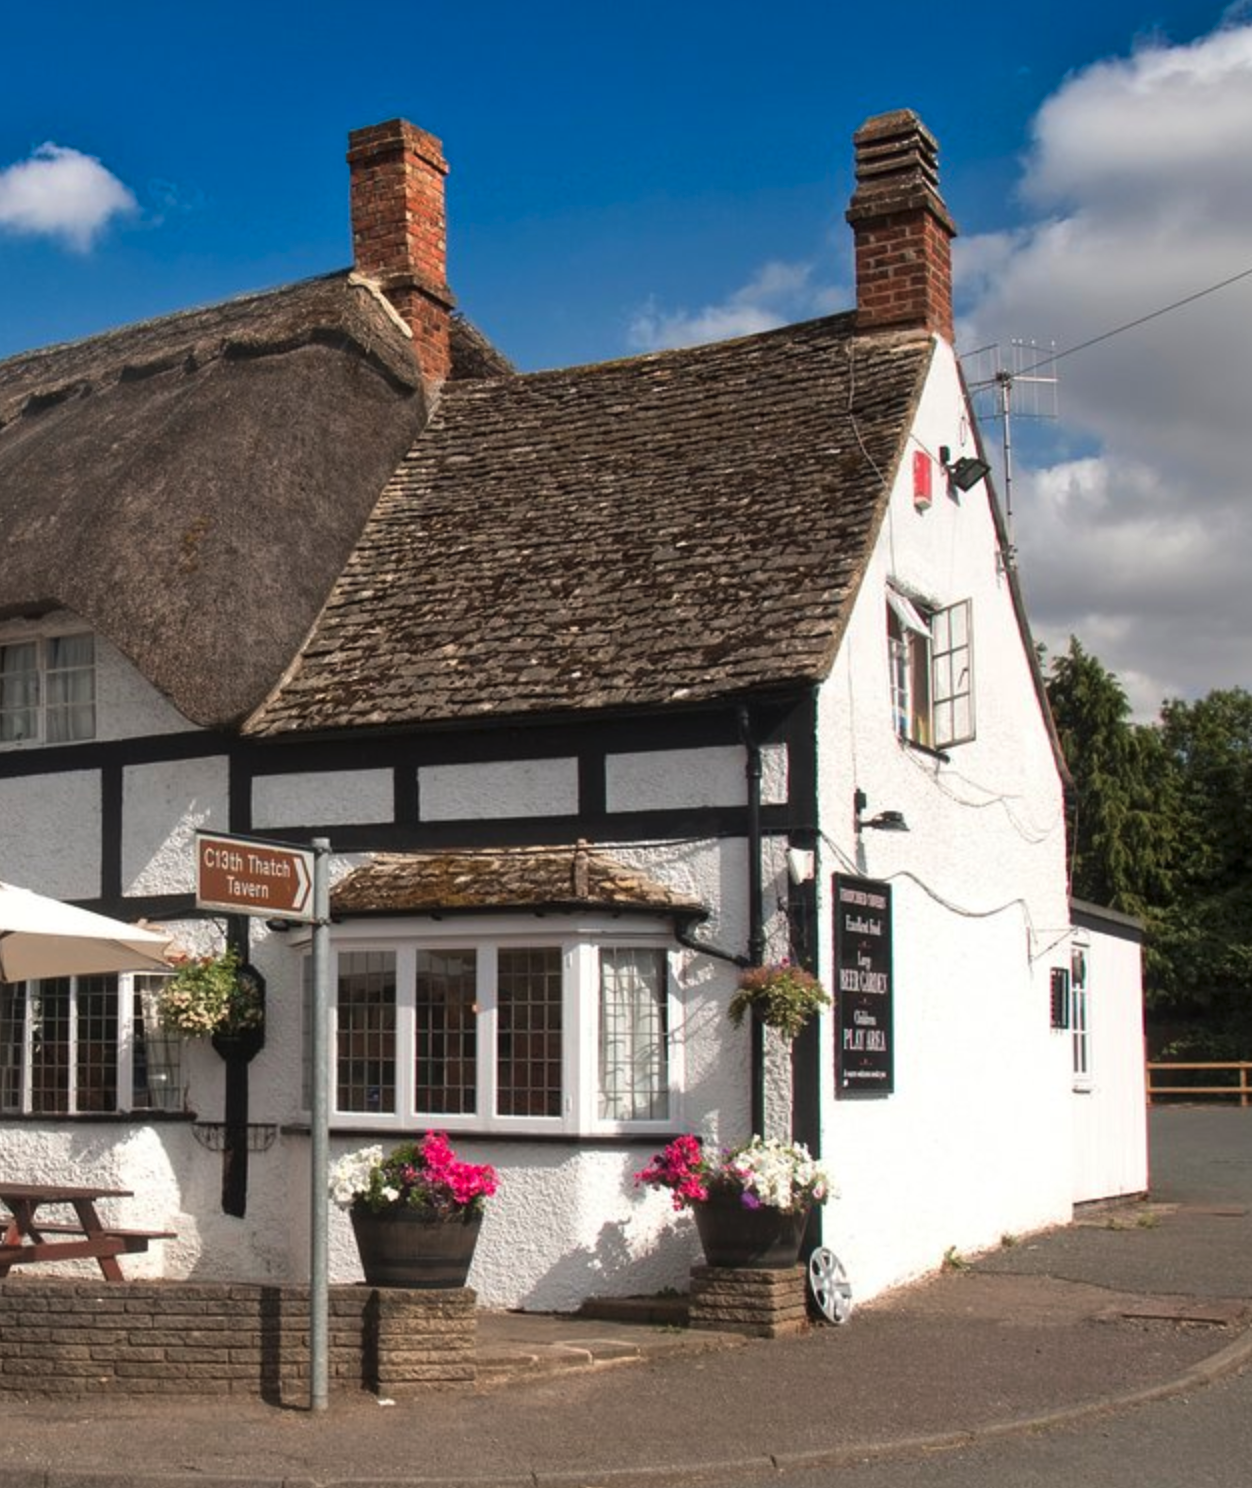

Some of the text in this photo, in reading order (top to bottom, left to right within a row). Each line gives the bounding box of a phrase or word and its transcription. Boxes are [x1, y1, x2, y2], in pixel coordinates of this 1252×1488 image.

[204, 847, 291, 877] C13th Thatch
[227, 875, 269, 899] Tavern
[840, 968, 860, 991] BEER
[843, 1029, 887, 1052] PLAY AREA
